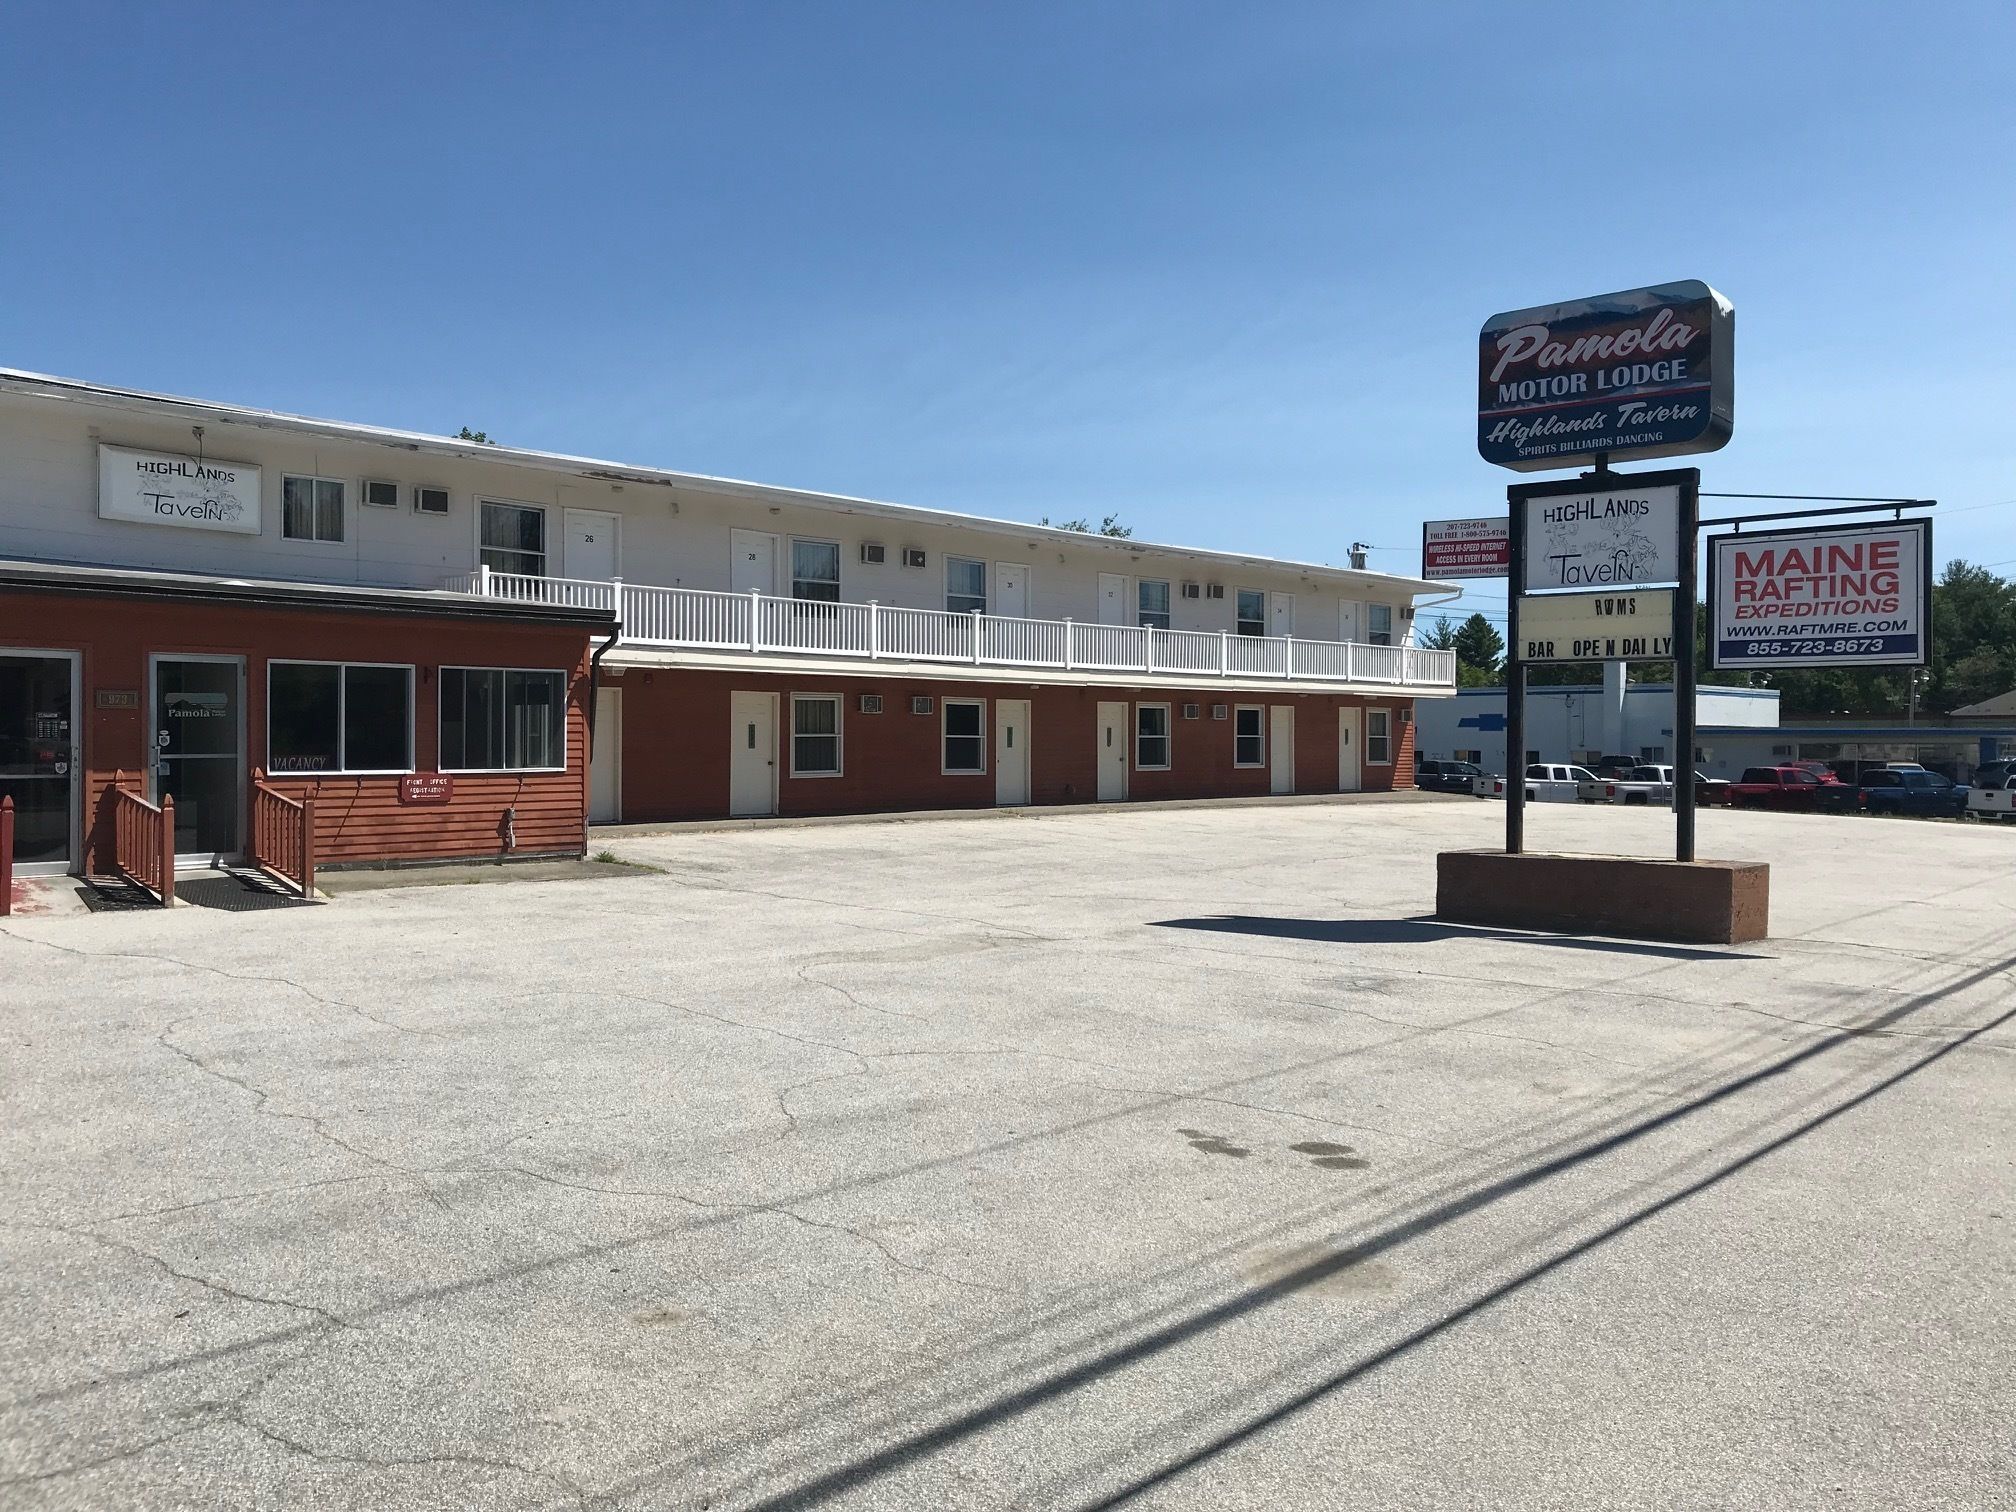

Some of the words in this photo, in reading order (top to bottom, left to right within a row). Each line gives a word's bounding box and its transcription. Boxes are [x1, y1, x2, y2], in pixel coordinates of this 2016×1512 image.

[1489, 307, 1701, 383] Pamola
[1498, 373, 1587, 404] MOTOR
[1597, 358, 1688, 389] LODGE
[1486, 412, 1605, 448] Highlands
[1617, 401, 1701, 428] Tavern
[1518, 443, 1557, 457] SPIRITS
[1559, 436, 1613, 453] BILLIARDS
[1616, 431, 1663, 446] DANCING
[136, 461, 235, 483] HIGHLANDS
[1544, 498, 1649, 523] HIGHLANDS
[584, 534, 594, 544] 26
[1428, 544, 1455, 554] WIRELESS
[1480, 541, 1507, 551] INTERNET
[1435, 555, 1456, 564] ACCESS
[1457, 554, 1463, 563] IN
[1464, 553, 1481, 563] EVERY
[1481, 553, 1498, 562] ROOM
[1735, 540, 1900, 578] MAINE
[1734, 571, 1900, 603] RAFTING
[1734, 597, 1900, 620] EXPEDITIONS
[1727, 620, 1908, 637] WWW.RAFTMRE.COM
[1528, 641, 1554, 658] BAR
[1747, 638, 1883, 655] 855-723-8673
[168, 709, 210, 718] Pamola
[274, 757, 326, 770] VACANCY
